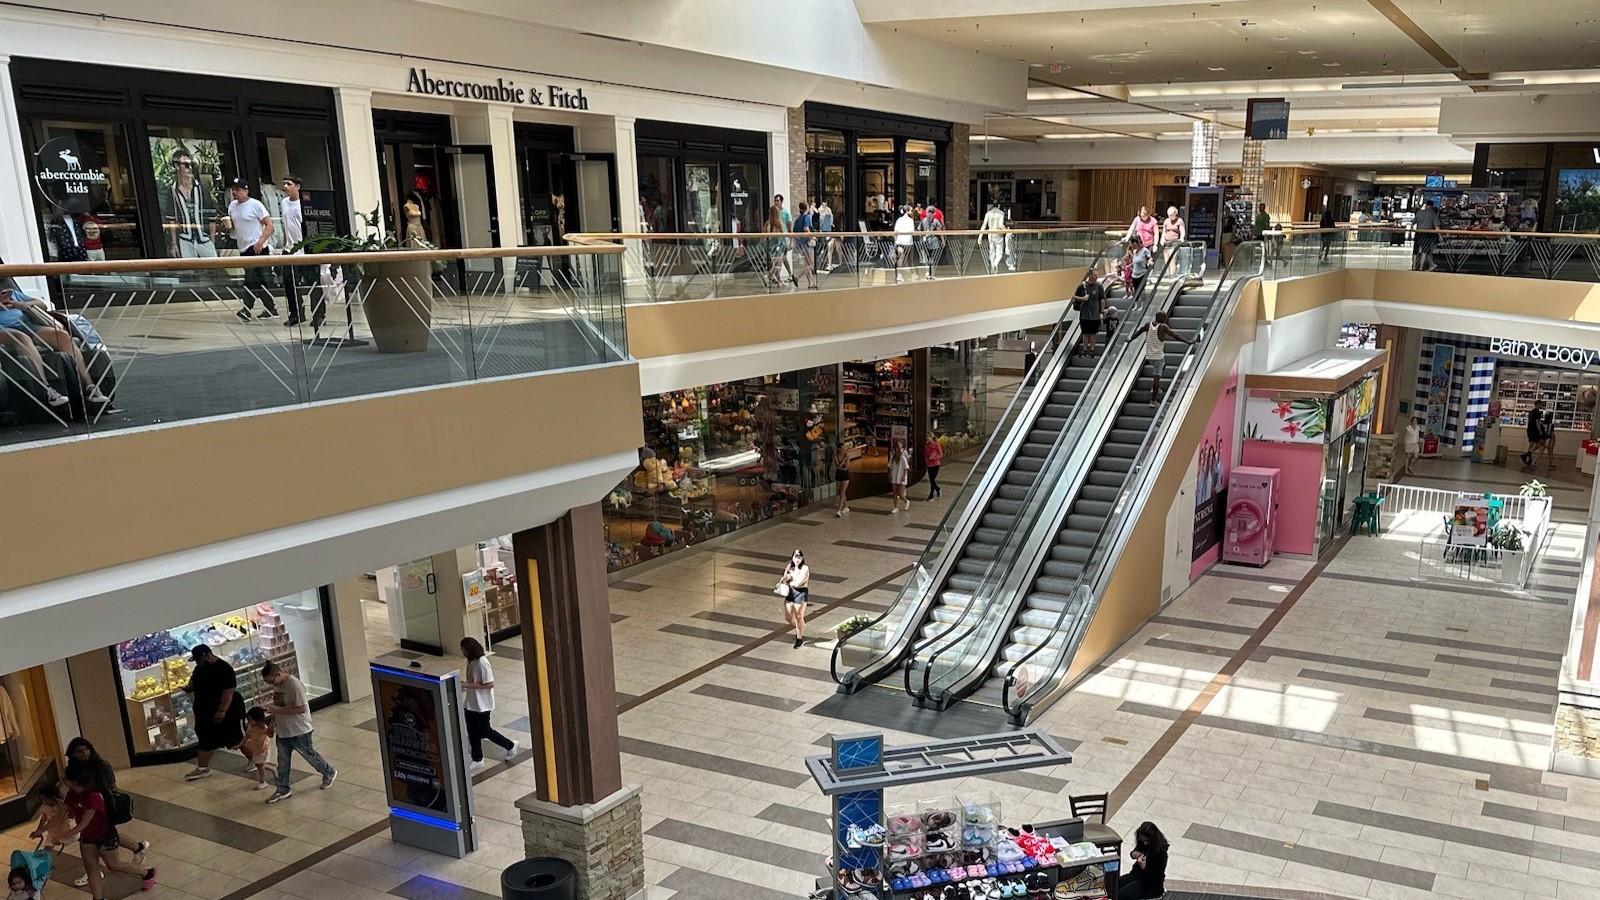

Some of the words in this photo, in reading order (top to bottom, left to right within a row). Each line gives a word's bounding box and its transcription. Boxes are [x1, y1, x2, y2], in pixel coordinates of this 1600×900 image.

[407, 67, 525, 104] Abercrombie
[529, 88, 544, 105] &
[547, 85, 589, 110] Fitch
[40, 167, 105, 180] abercrombie
[65, 182, 89, 193] kids
[1489, 337, 1527, 357] Bath
[1530, 341, 1543, 359] &
[1546, 344, 1595, 369] Body
